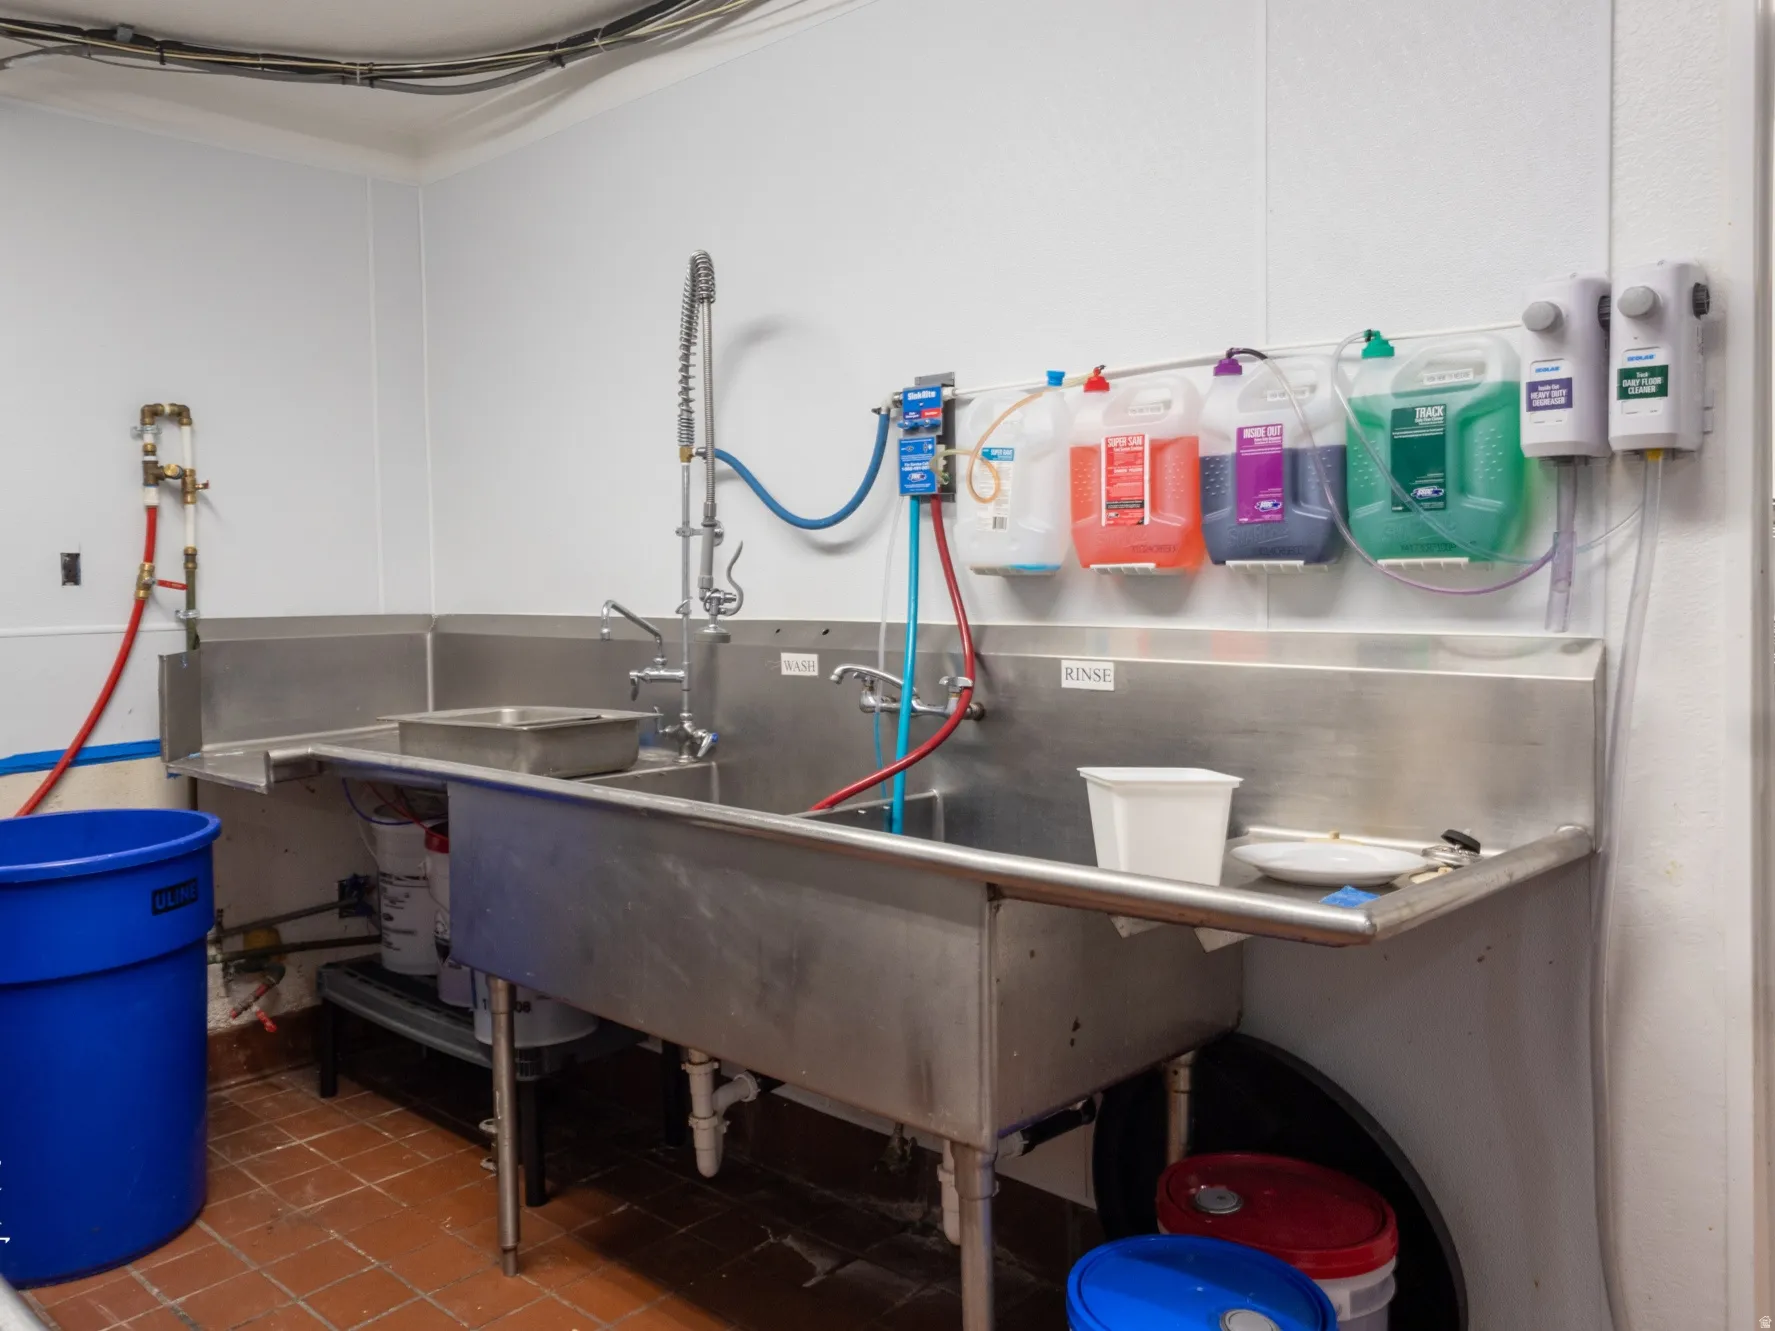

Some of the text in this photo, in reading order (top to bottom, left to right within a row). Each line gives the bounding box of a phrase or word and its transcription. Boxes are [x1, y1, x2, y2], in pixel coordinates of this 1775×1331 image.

[1622, 377, 1661, 387] DAILY FLOOR
[1530, 389, 1566, 400] HEAVY DUTY
[1627, 385, 1656, 394] CLEANER
[1532, 397, 1565, 407] DEGREASER
[1415, 405, 1444, 418] TRACK
[1243, 425, 1282, 439] INSIDE OUT
[1107, 435, 1143, 447] SUPER SAN
[783, 659, 815, 672] WASH
[1064, 666, 1112, 683] RINSE
[154, 881, 196, 910] ULINE
